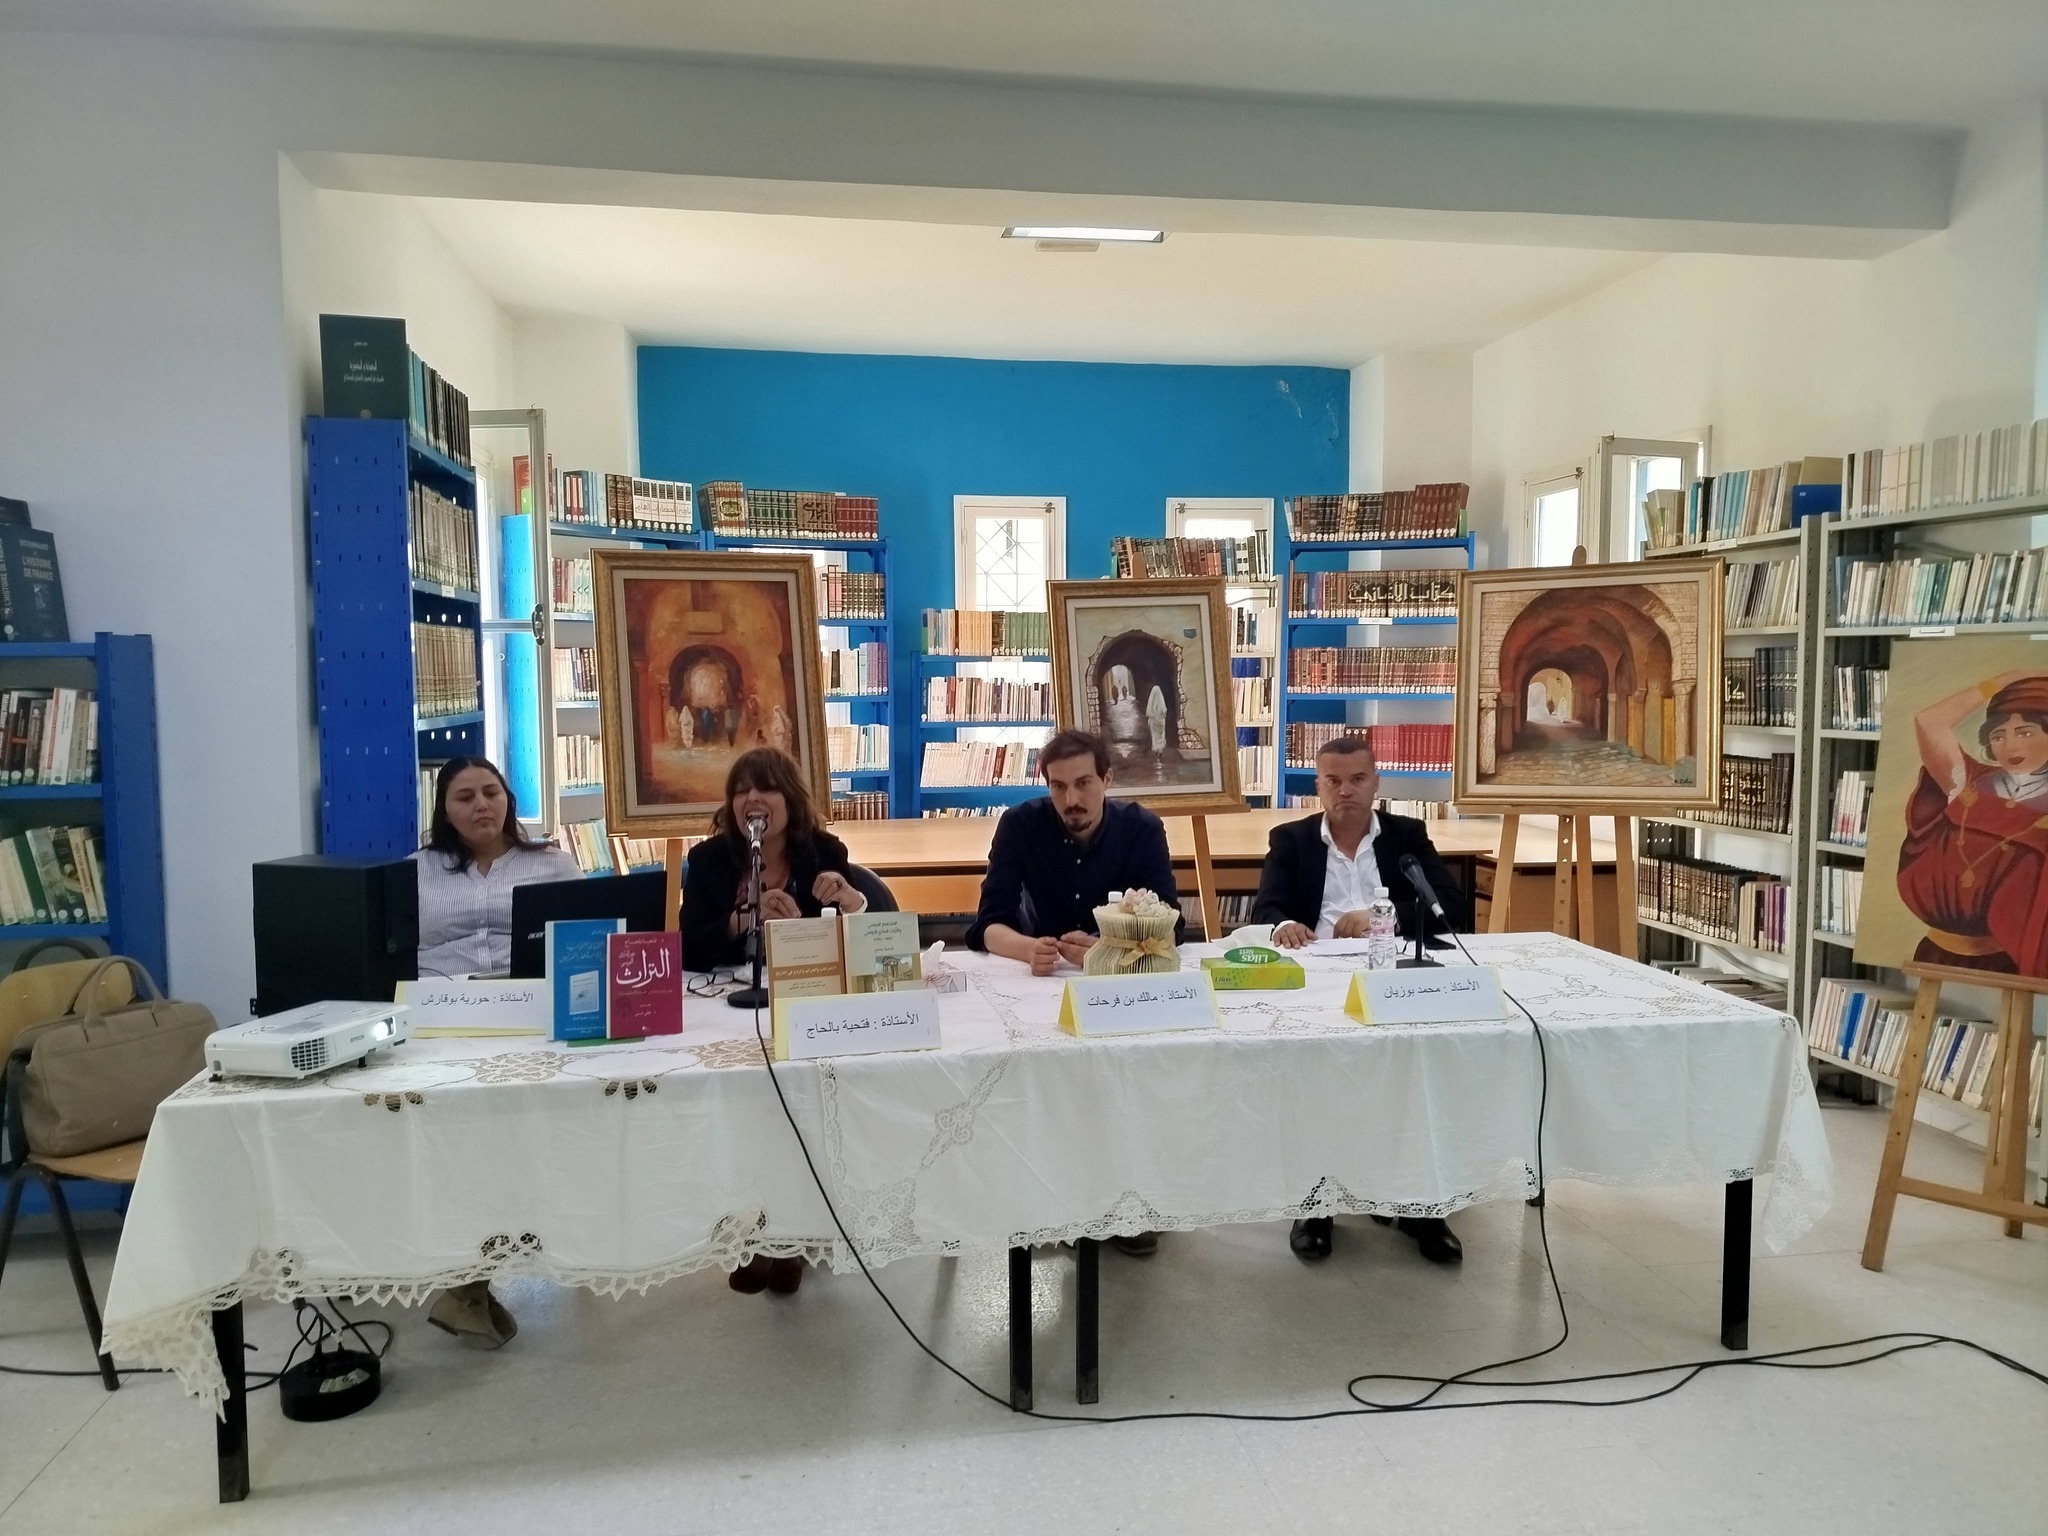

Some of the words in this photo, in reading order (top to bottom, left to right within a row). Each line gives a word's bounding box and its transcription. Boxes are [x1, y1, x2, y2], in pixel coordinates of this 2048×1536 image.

[1410, 581, 1455, 602] كتاب
[1241, 954, 1269, 963] Lilas
[616, 947, 671, 988] التراث
[1384, 985, 1415, 999] بوزيان
[1418, 987, 1441, 995] محمد
[1450, 978, 1480, 992] الأستاذ
[460, 993, 490, 1005] حورية
[500, 990, 534, 1003] الأستاذة
[1087, 993, 1121, 1008] فرحات
[1137, 991, 1158, 1003] مالك
[1168, 987, 1198, 1000] الأستاذ
[1123, 997, 1134, 1007] بن
[842, 1018, 870, 1033] فتحية
[881, 1011, 919, 1027] الأستاذة
[806, 1022, 840, 1039] بالحاج
